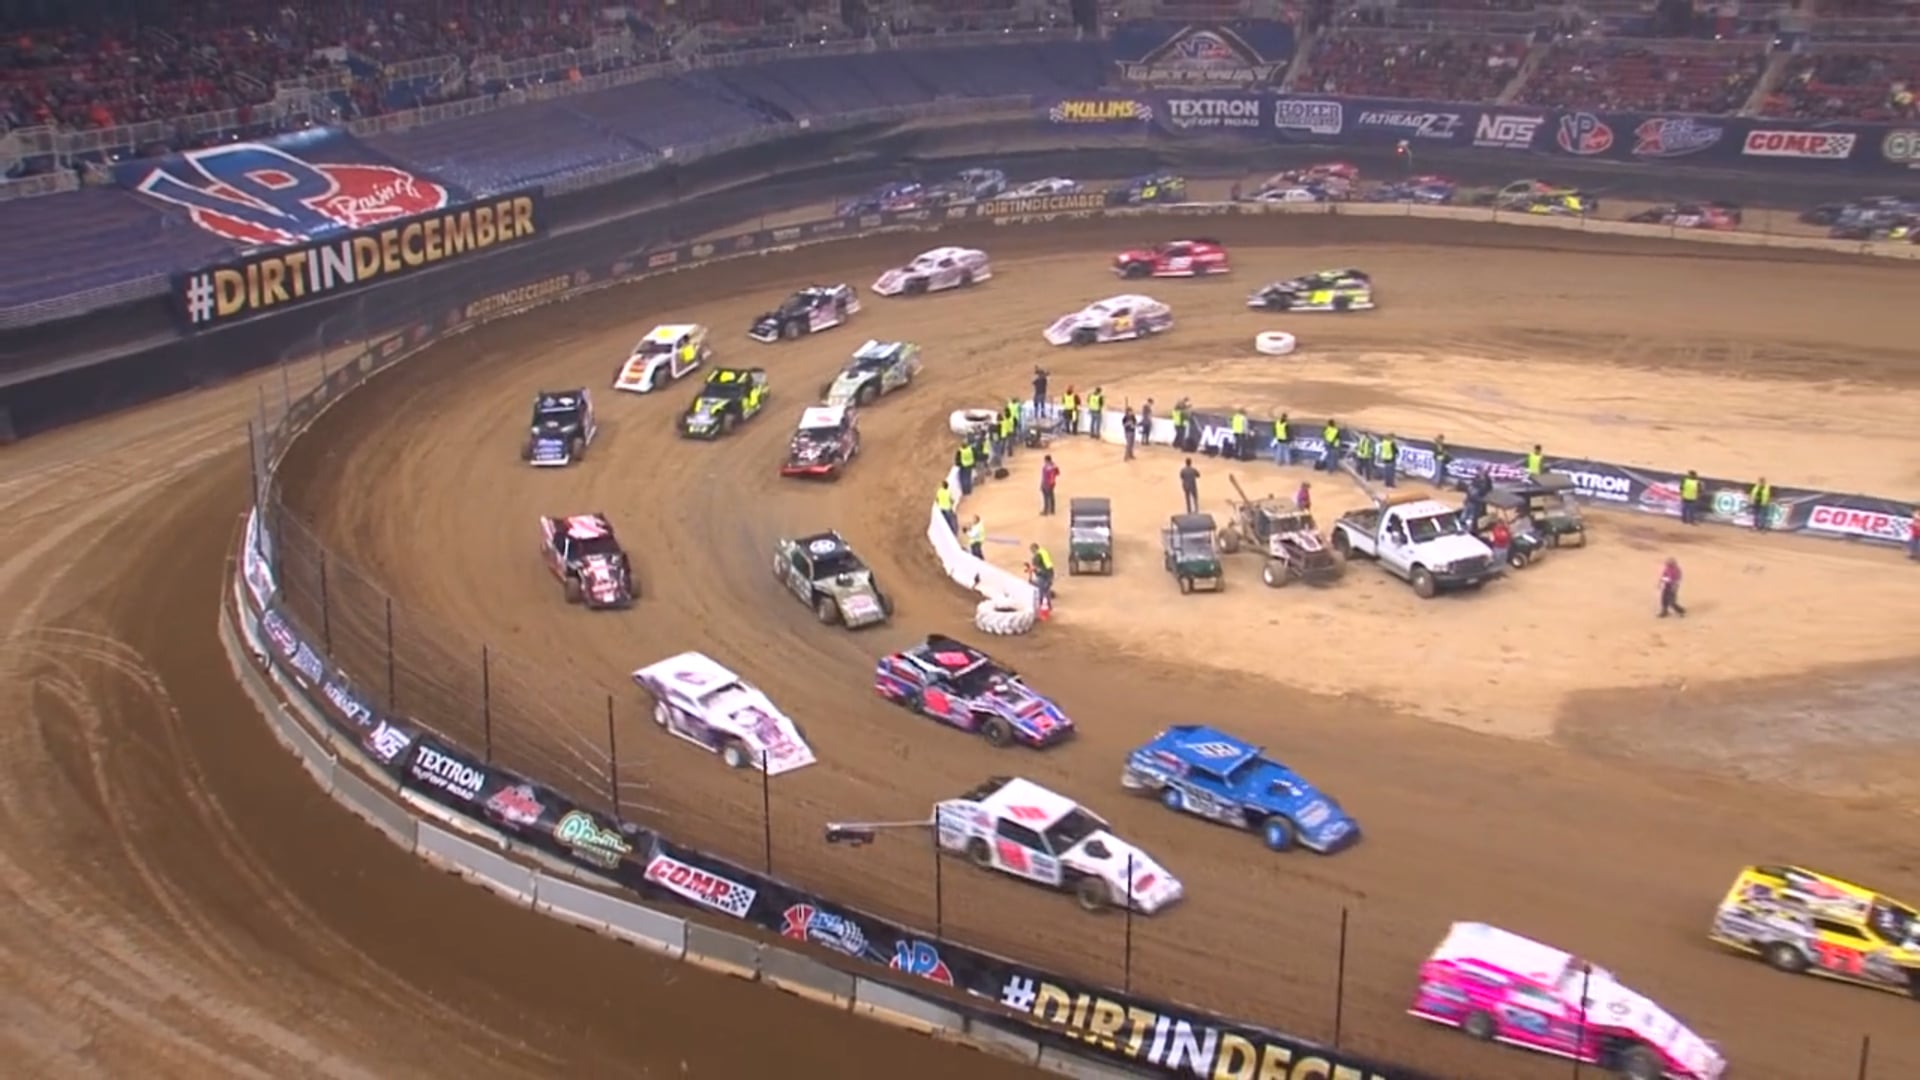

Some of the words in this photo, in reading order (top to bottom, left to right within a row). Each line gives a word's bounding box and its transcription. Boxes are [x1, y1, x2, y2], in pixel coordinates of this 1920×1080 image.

[1064, 101, 1136, 118] MULLINS
[1168, 100, 1259, 116] TEXTRON
[1475, 114, 1544, 141] NOS
[1748, 134, 1826, 154] COMP
[138, 143, 340, 239] VP
[186, 196, 535, 323] #DIRTINDECEMBER
[1813, 509, 1889, 530] COMP
[371, 720, 410, 759] NOS
[416, 746, 485, 792] TEXTRON
[648, 859, 731, 898] COMP
[895, 939, 940, 974] VP
